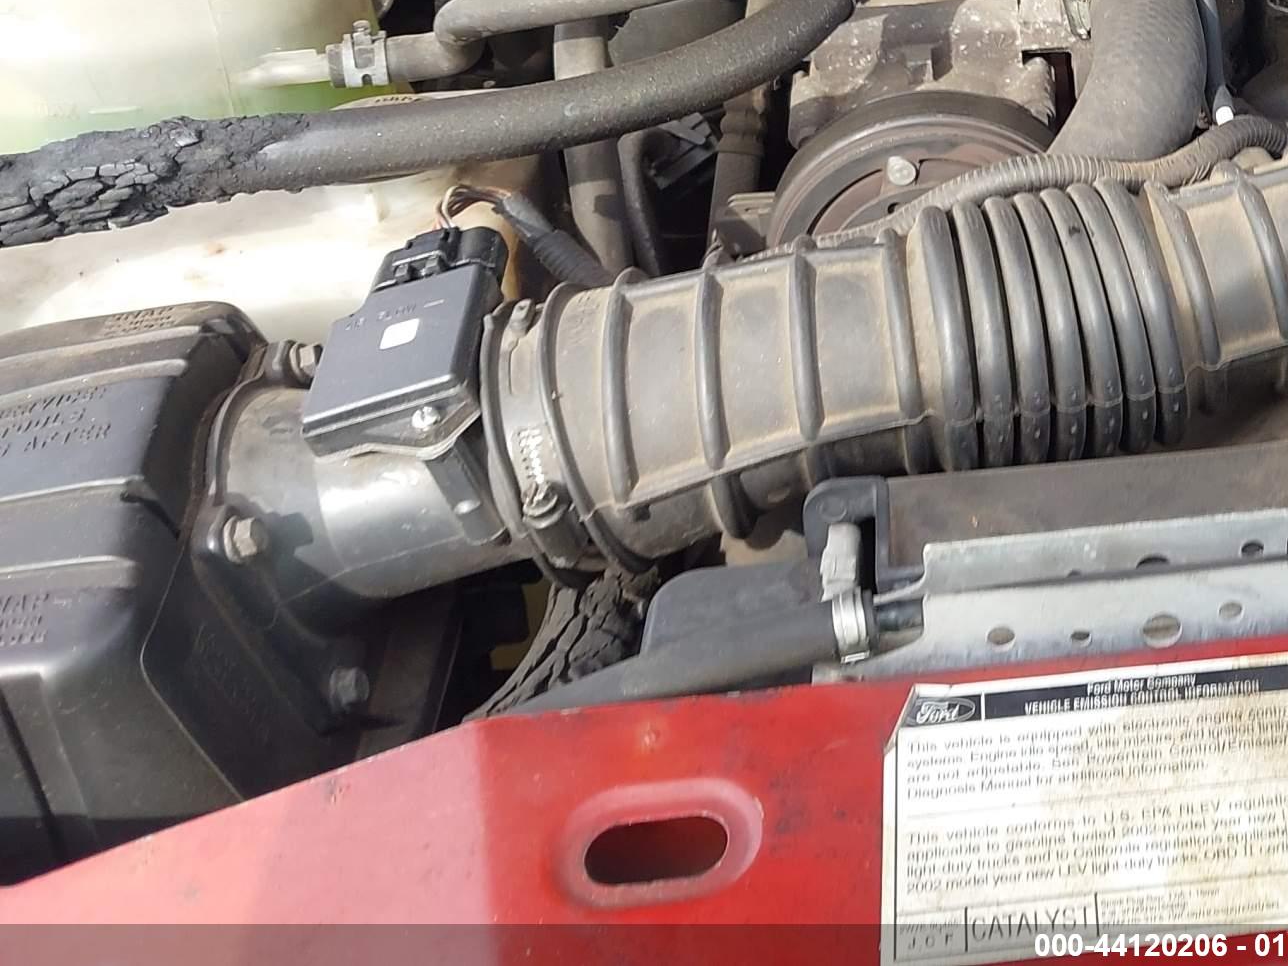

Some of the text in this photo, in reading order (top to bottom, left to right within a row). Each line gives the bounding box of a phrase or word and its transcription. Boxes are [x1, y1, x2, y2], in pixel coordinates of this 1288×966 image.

[1025, 679, 1259, 715] VEHICLE EMISSION CONTROL INFORMATION
[1087, 672, 1195, 696] Ford Motor Company
[916, 699, 959, 723] Ford
[908, 739, 937, 754] This
[944, 735, 992, 749] vehicle
[999, 732, 1010, 744] is
[1017, 725, 1081, 744] equipped
[1088, 721, 1115, 735] with
[1122, 714, 1189, 730] electronic
[1196, 710, 1242, 724] engine
[970, 748, 1016, 763] Engine
[1020, 744, 1043, 756] idle
[1097, 736, 1119, 748] idle
[1180, 727, 1204, 739] and
[907, 773, 929, 784] are
[937, 768, 958, 781] not
[1087, 747, 1161, 763] Powertrain
[907, 782, 975, 801] Diagnosis
[981, 776, 1028, 790] Manual
[1036, 773, 1053, 785] for
[1058, 766, 1123, 782] additional
[906, 843, 980, 862] applicable
[987, 839, 999, 852] to
[1006, 833, 1065, 851] gasoline
[1072, 827, 1115, 841] fueled
[1162, 817, 1205, 831] model
[908, 829, 937, 845] This
[947, 824, 997, 840] vehicle
[1007, 815, 1074, 833] conforms
[1082, 812, 1096, 826] to
[1142, 804, 1170, 819] EPA
[978, 854, 1018, 867] trucks
[1024, 849, 1050, 863] and
[1056, 847, 1068, 860] to
[1073, 840, 1139, 857] California
[1146, 831, 1222, 852] regulations
[906, 878, 941, 894] 2002
[946, 874, 987, 889] model
[993, 870, 1021, 887] year
[1026, 867, 1053, 881] new
[1059, 861, 1087, 877] LEV
[971, 907, 1086, 940] CATALYST
